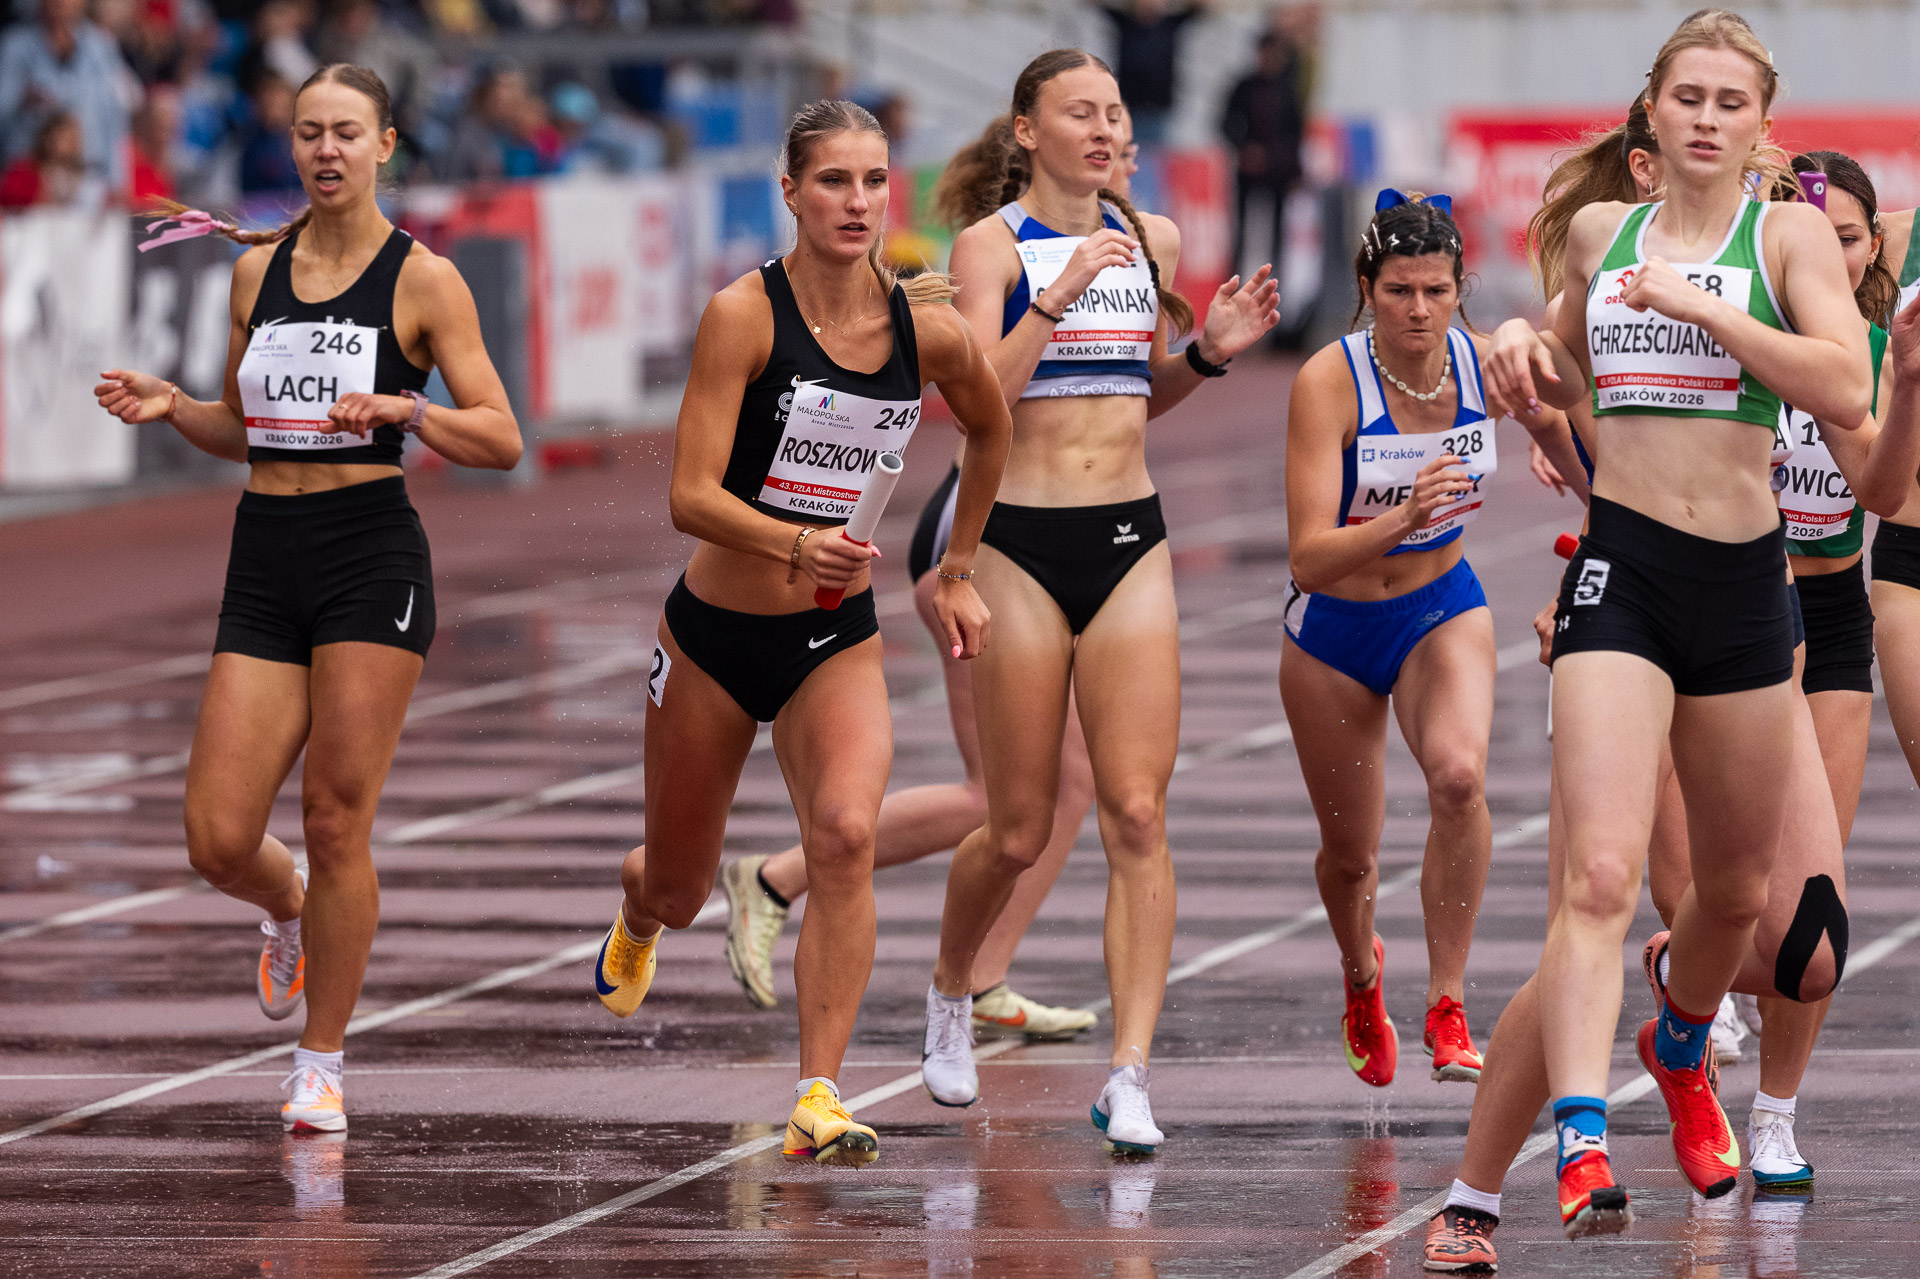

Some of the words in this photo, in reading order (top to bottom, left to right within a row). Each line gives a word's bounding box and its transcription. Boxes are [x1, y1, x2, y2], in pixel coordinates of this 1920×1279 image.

[1605, 296, 1624, 304] ORL
[310, 330, 362, 355] 246
[1056, 333, 1075, 341] PZLA
[1077, 332, 1119, 340] Mistrzostwa
[1057, 342, 1114, 356] KRAKÓW
[265, 375, 337, 403] LACH
[1049, 385, 1079, 396] AZS
[1080, 381, 1137, 396] POZNAŃ
[1622, 375, 1676, 386] Mistrzostwa
[1678, 378, 1705, 388] Polski
[1707, 379, 1724, 389] U23
[1609, 388, 1666, 402] KRAKÓW
[1668, 392, 1704, 405] 2026
[797, 406, 850, 422] MAŁOPOLSKA
[874, 405, 920, 430] 249
[275, 421, 318, 430] Mistrzostwa
[828, 422, 855, 430] Mistrzostw
[265, 433, 309, 445] KRAKÓW
[312, 435, 344, 445] 2026
[1441, 430, 1483, 456] 328
[1380, 448, 1425, 460] Kraków
[779, 482, 791, 491] 43.
[792, 484, 811, 493] PZLA
[812, 487, 860, 500] Mistrzostwa
[789, 497, 849, 514] KRAKÓW
[1800, 514, 1826, 523] Polski
[1827, 515, 1841, 523] U23
[1791, 526, 1824, 537] 2026
[1113, 534, 1140, 544] erima
[1578, 569, 1604, 600] 5
[648, 648, 664, 698] 2
